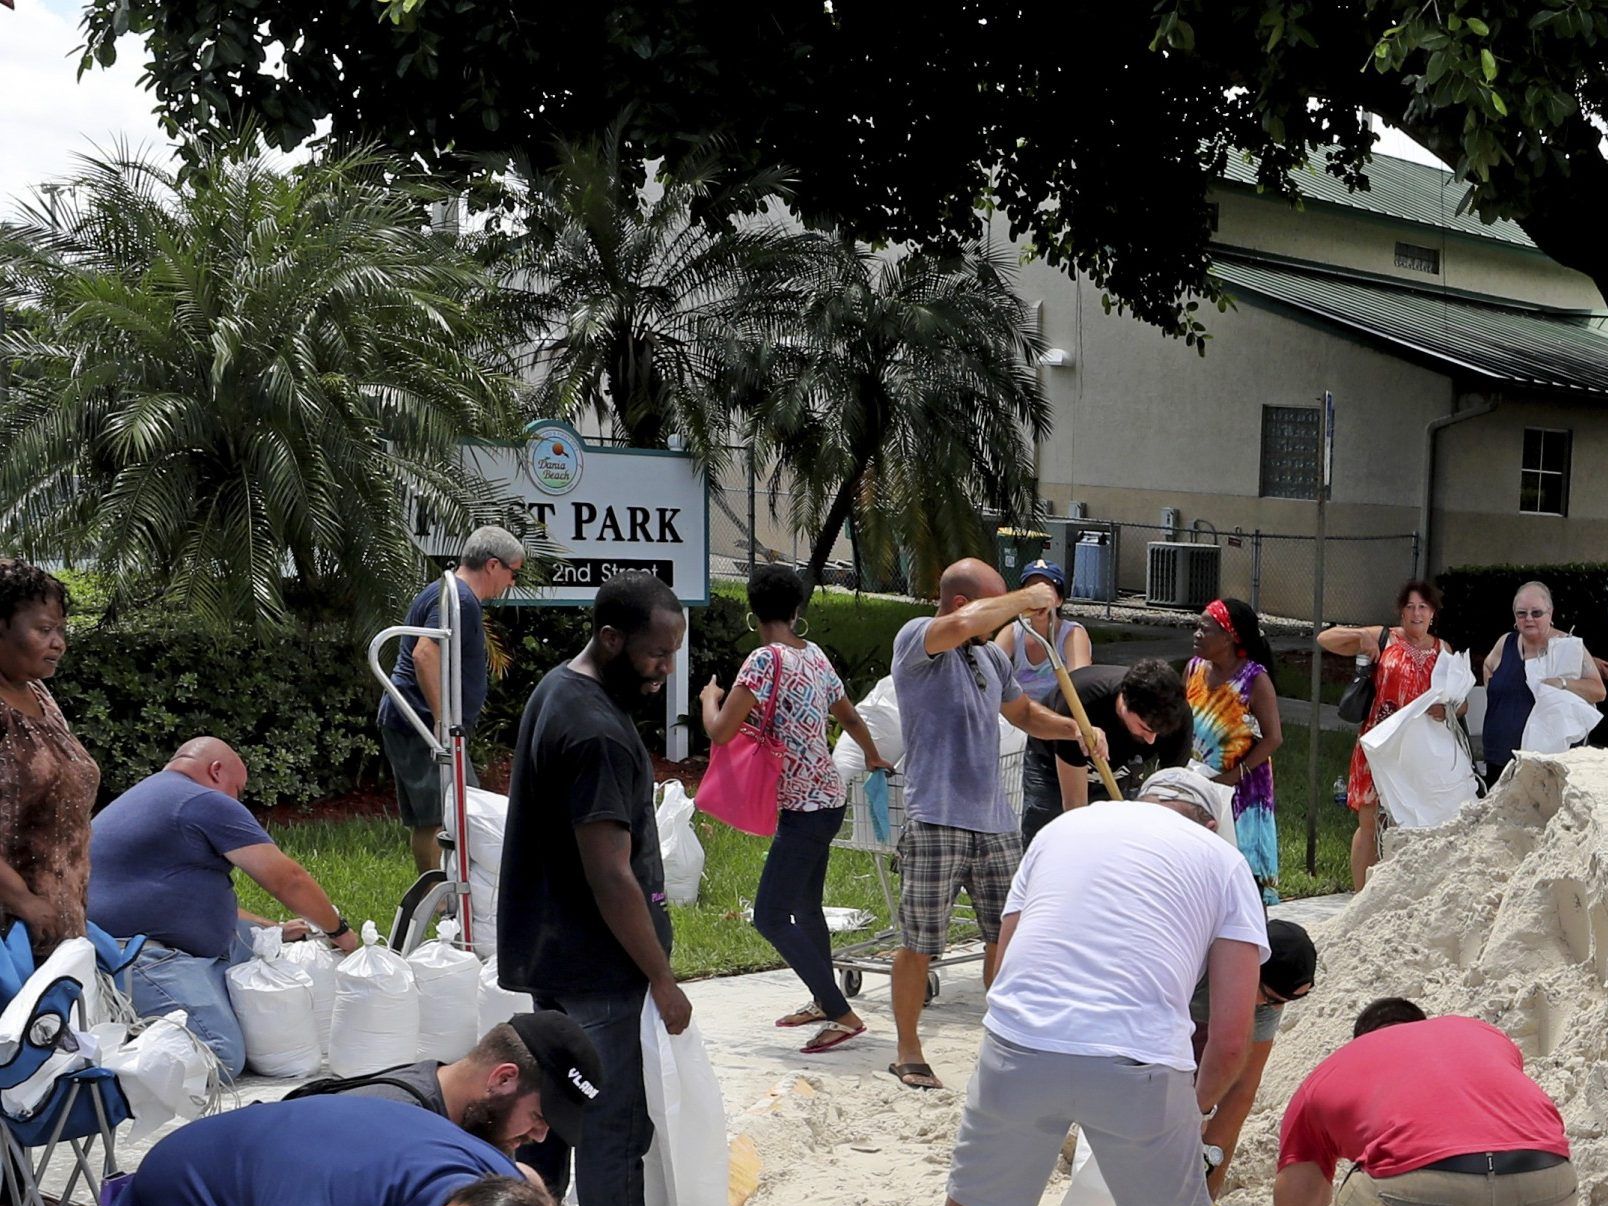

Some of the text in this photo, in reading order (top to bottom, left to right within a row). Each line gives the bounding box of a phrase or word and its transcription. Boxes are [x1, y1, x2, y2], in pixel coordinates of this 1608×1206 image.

[538, 459, 566, 470] Dania
[543, 469, 570, 480] Beach
[571, 502, 684, 543] PARK
[552, 563, 591, 582] 2nd
